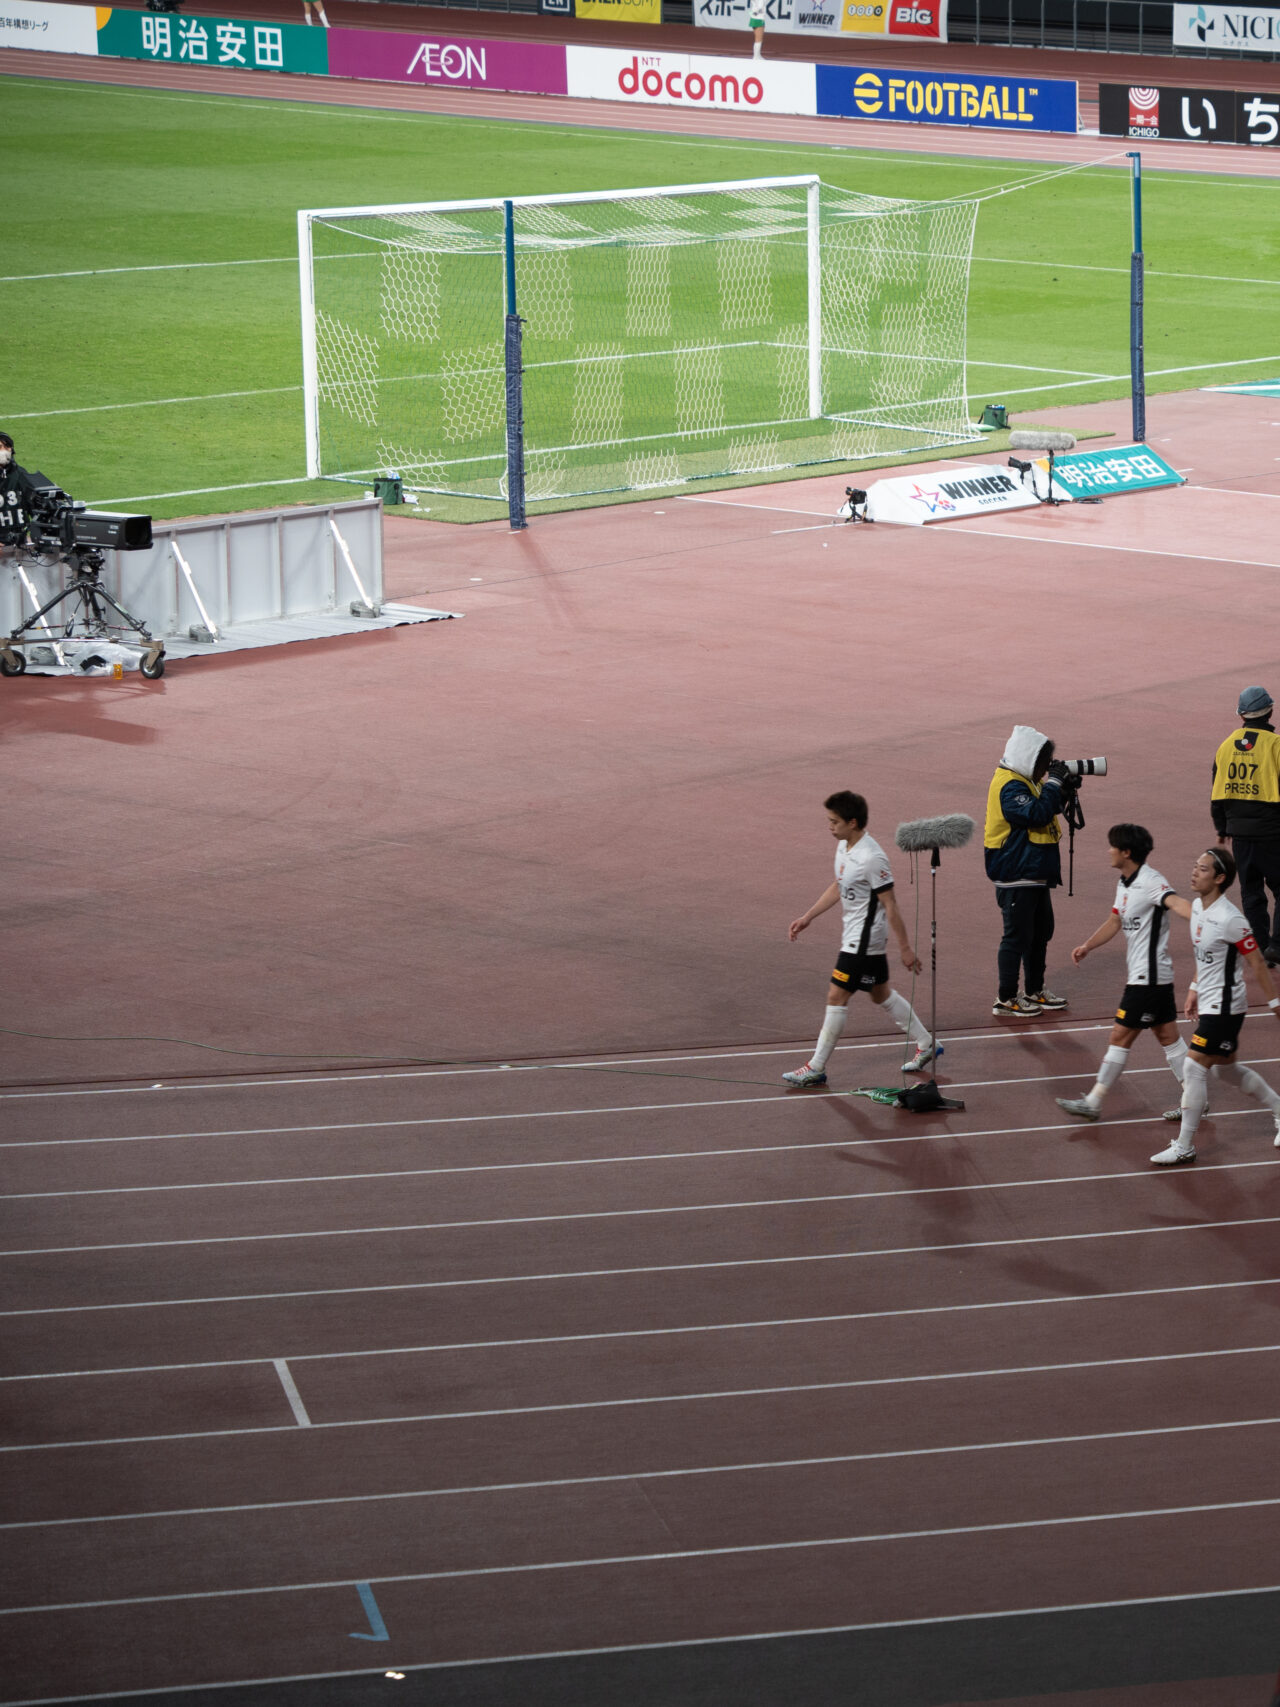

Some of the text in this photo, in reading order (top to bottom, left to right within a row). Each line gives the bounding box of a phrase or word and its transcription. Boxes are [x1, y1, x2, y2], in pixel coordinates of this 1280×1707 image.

[799, 13, 835, 25] WINNER
[141, 16, 284, 67] 明治安田
[641, 57, 661, 67] NTT
[618, 56, 764, 105] docomo
[1129, 126, 1160, 138] ICHIGO
[1055, 453, 1167, 488] 明治安田
[938, 475, 1018, 501] WINNER
[1228, 762, 1259, 780] 007
[1225, 783, 1259, 795] PRESS
[1243, 939, 1256, 950] C
